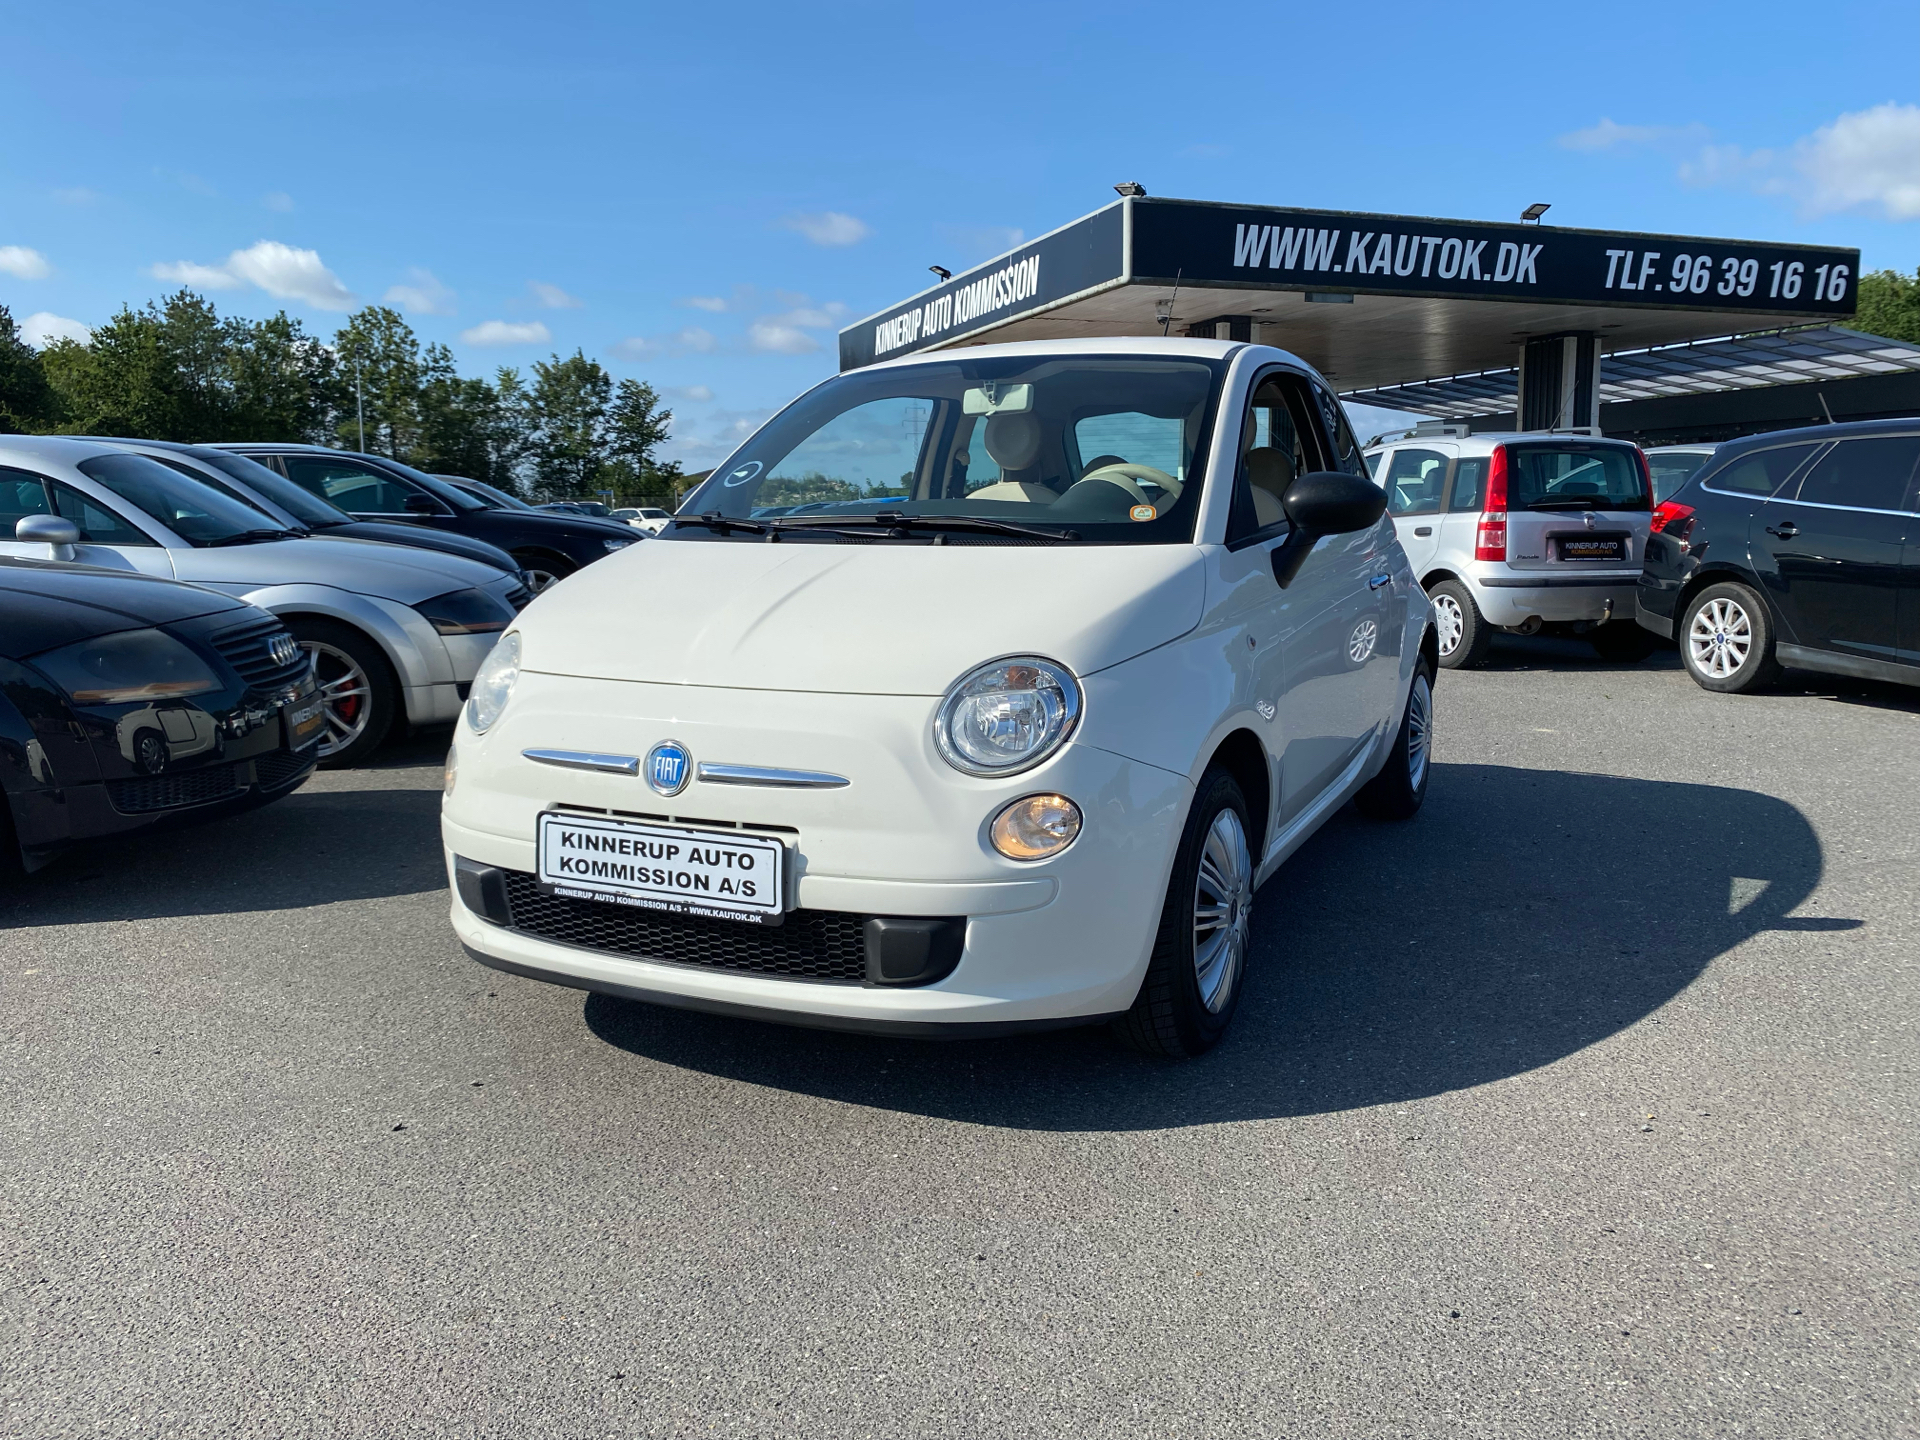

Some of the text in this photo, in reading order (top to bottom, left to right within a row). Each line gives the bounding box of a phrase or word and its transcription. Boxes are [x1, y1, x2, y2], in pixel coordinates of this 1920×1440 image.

[1233, 224, 1544, 284] WWW.KAUTOK.DK
[1605, 249, 1849, 302] TLF. 96 39 16 16
[875, 254, 1040, 355] KINNERUP AUTO KOMMISSION
[1565, 542, 1618, 550] KINNERUP AUTO
[655, 756, 682, 782] FIAT
[561, 831, 755, 870] KINNERUP AUTO
[560, 856, 757, 897] KOMMISSION A/S
[554, 887, 762, 923] KINNERUP AUTO KOMMISSION A/S WWW.KAUTOK.DK
